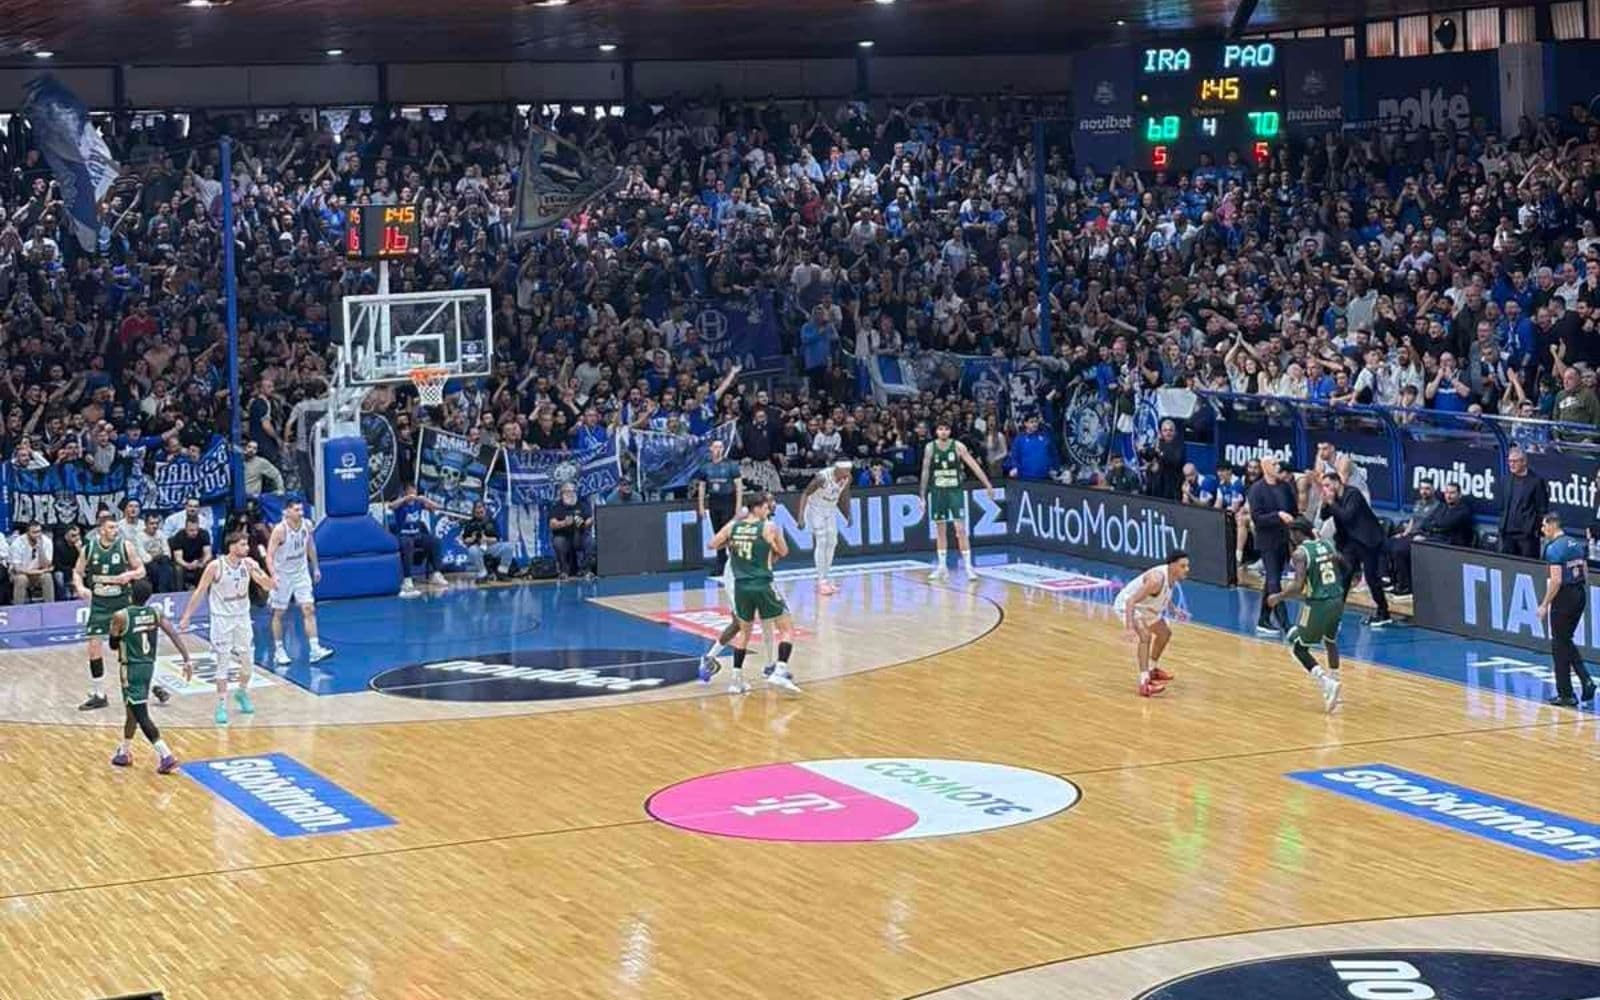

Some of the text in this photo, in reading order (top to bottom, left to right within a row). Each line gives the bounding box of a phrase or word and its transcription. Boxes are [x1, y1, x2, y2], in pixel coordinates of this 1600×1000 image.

[1144, 44, 1275, 71] IRA PAO
[1202, 78, 1239, 100] 1:45
[1080, 115, 1132, 130] novibet
[1148, 116, 1180, 140] 68
[1203, 118, 1216, 136] 4
[1248, 112, 1279, 136] 70
[1287, 105, 1342, 121] novibet
[1153, 146, 1167, 165] 5
[1225, 438, 1292, 467] novibet
[1016, 490, 1187, 560] AutoMobility
[209, 759, 351, 827] Stoiximan
[864, 761, 1032, 816] COSMOTE
